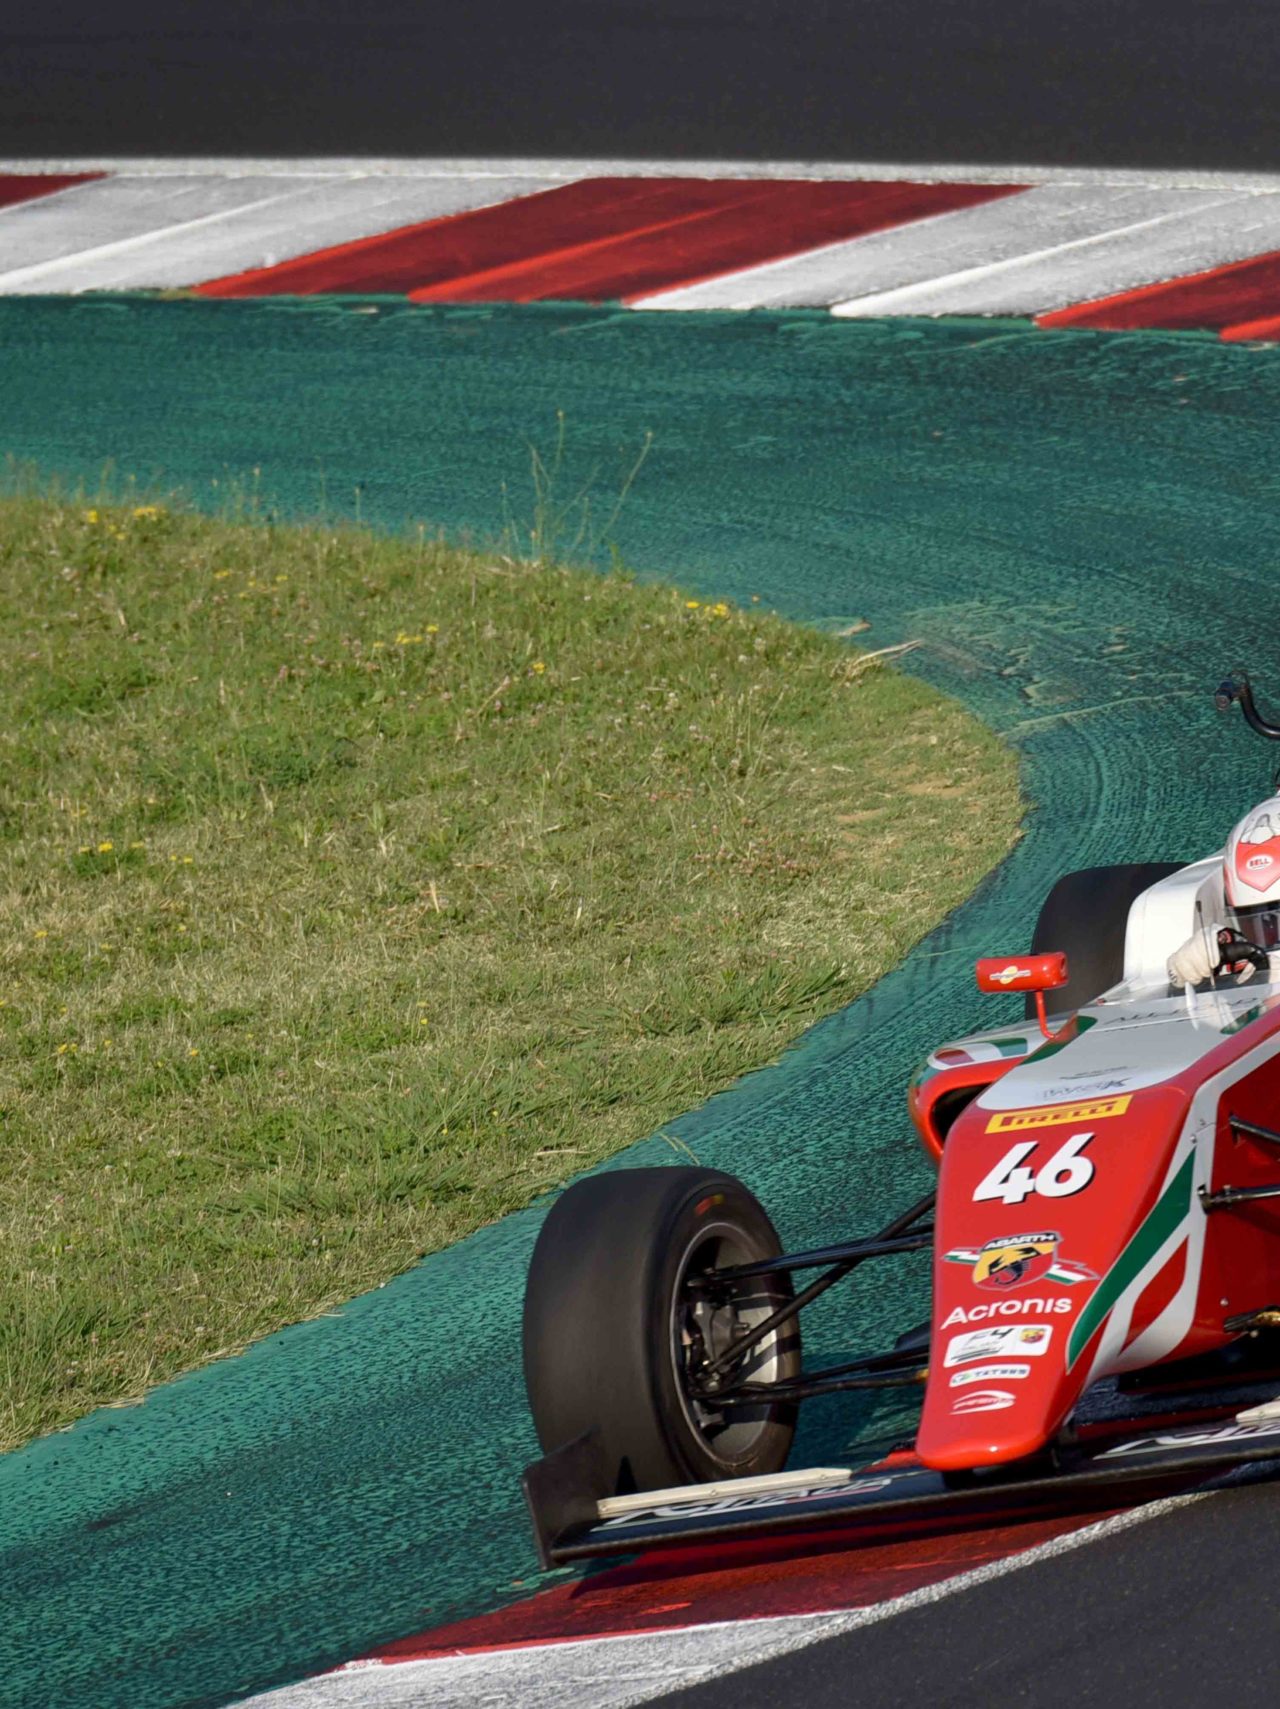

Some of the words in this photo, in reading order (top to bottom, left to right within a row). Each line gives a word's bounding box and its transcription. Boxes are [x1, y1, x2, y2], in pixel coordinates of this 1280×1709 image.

[1000, 1101, 1119, 1128] PIRELLI
[972, 1132, 1096, 1205] 46
[984, 1233, 1054, 1250] ABARTH
[940, 1297, 1073, 1330] Acronis
